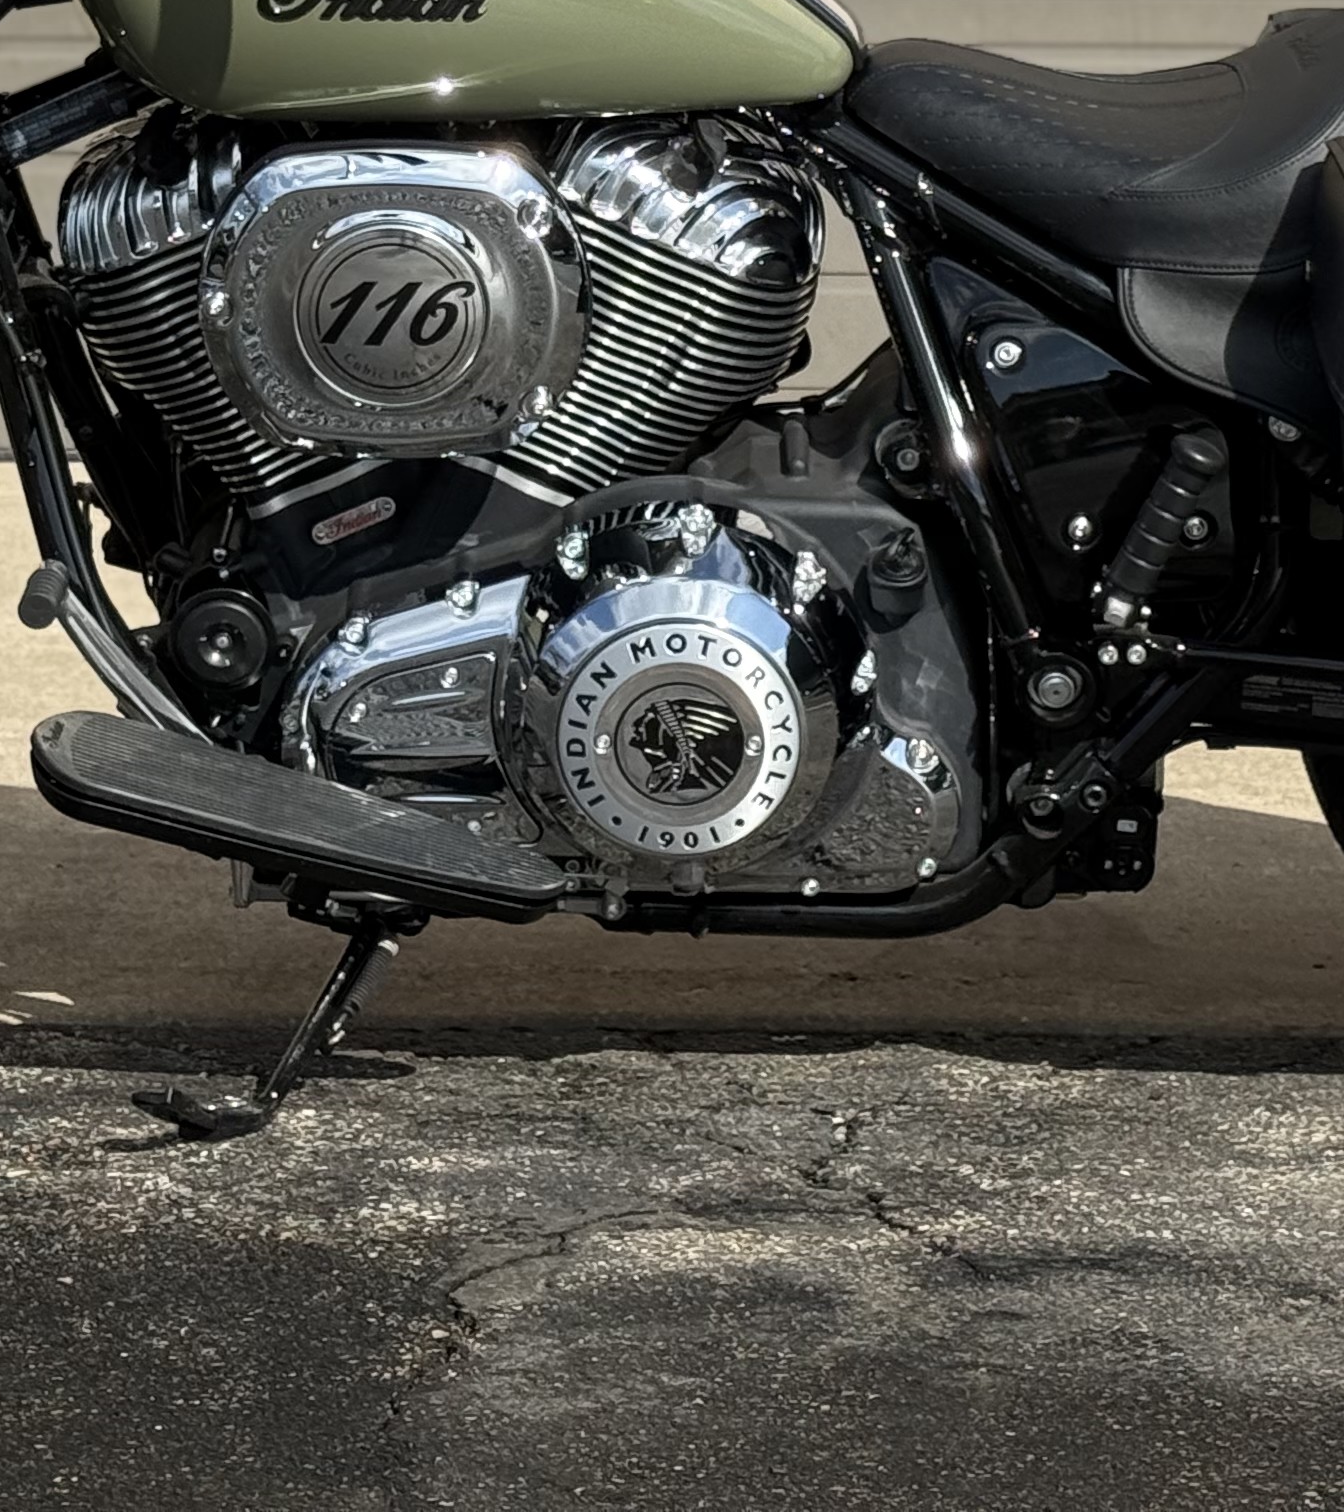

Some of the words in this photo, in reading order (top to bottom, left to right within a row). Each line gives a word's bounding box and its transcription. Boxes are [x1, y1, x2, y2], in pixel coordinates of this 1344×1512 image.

[319, 280, 476, 347] 116
[566, 662, 618, 808] INDIAN
[629, 633, 794, 811] MOTORCYCLE
[638, 824, 722, 849] 1901
